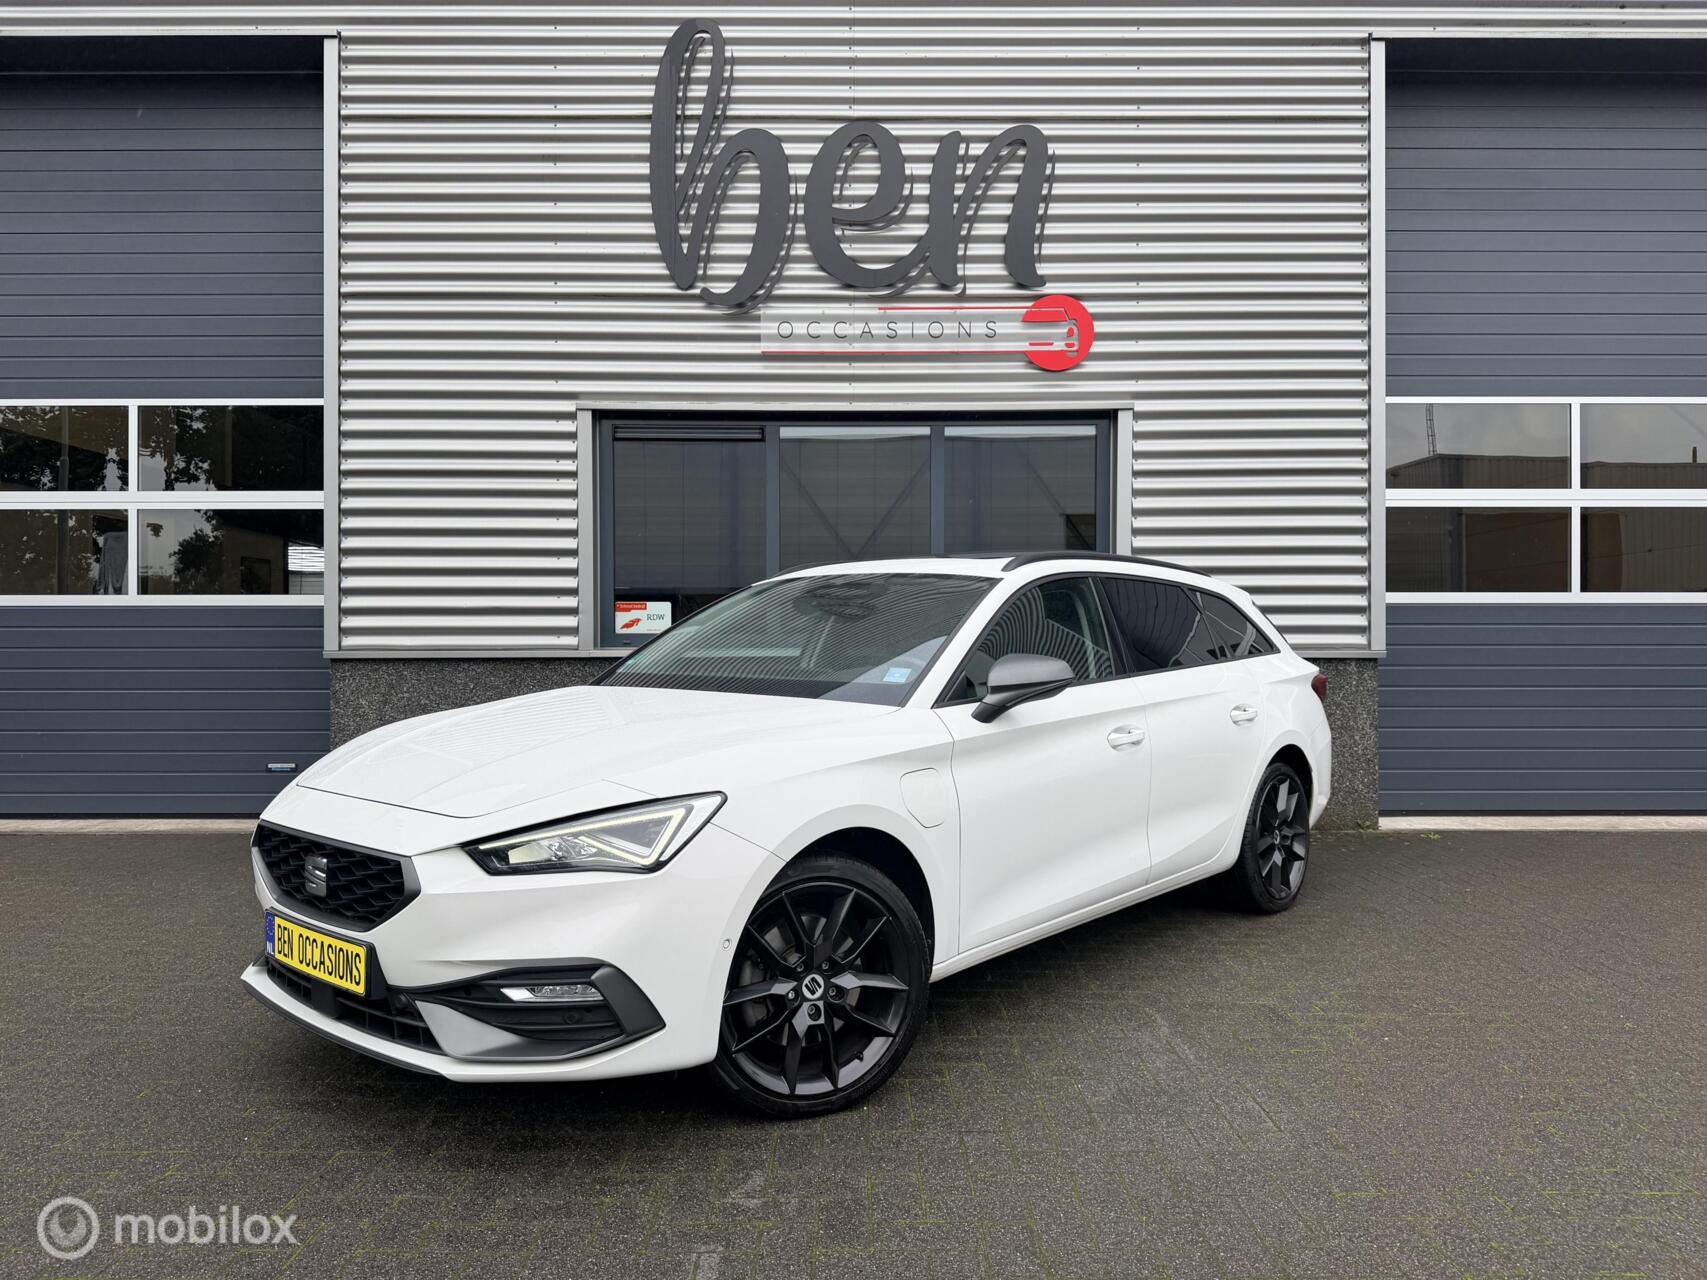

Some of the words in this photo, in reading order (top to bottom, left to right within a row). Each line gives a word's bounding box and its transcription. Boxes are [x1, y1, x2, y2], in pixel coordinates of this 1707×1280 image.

[649, 18, 1047, 306] ben
[777, 320, 998, 340] OCCASIONS
[646, 613, 665, 621] RDW
[266, 941, 275, 956] NL
[277, 923, 294, 961] BEN
[298, 933, 362, 987] OCCASIONS
